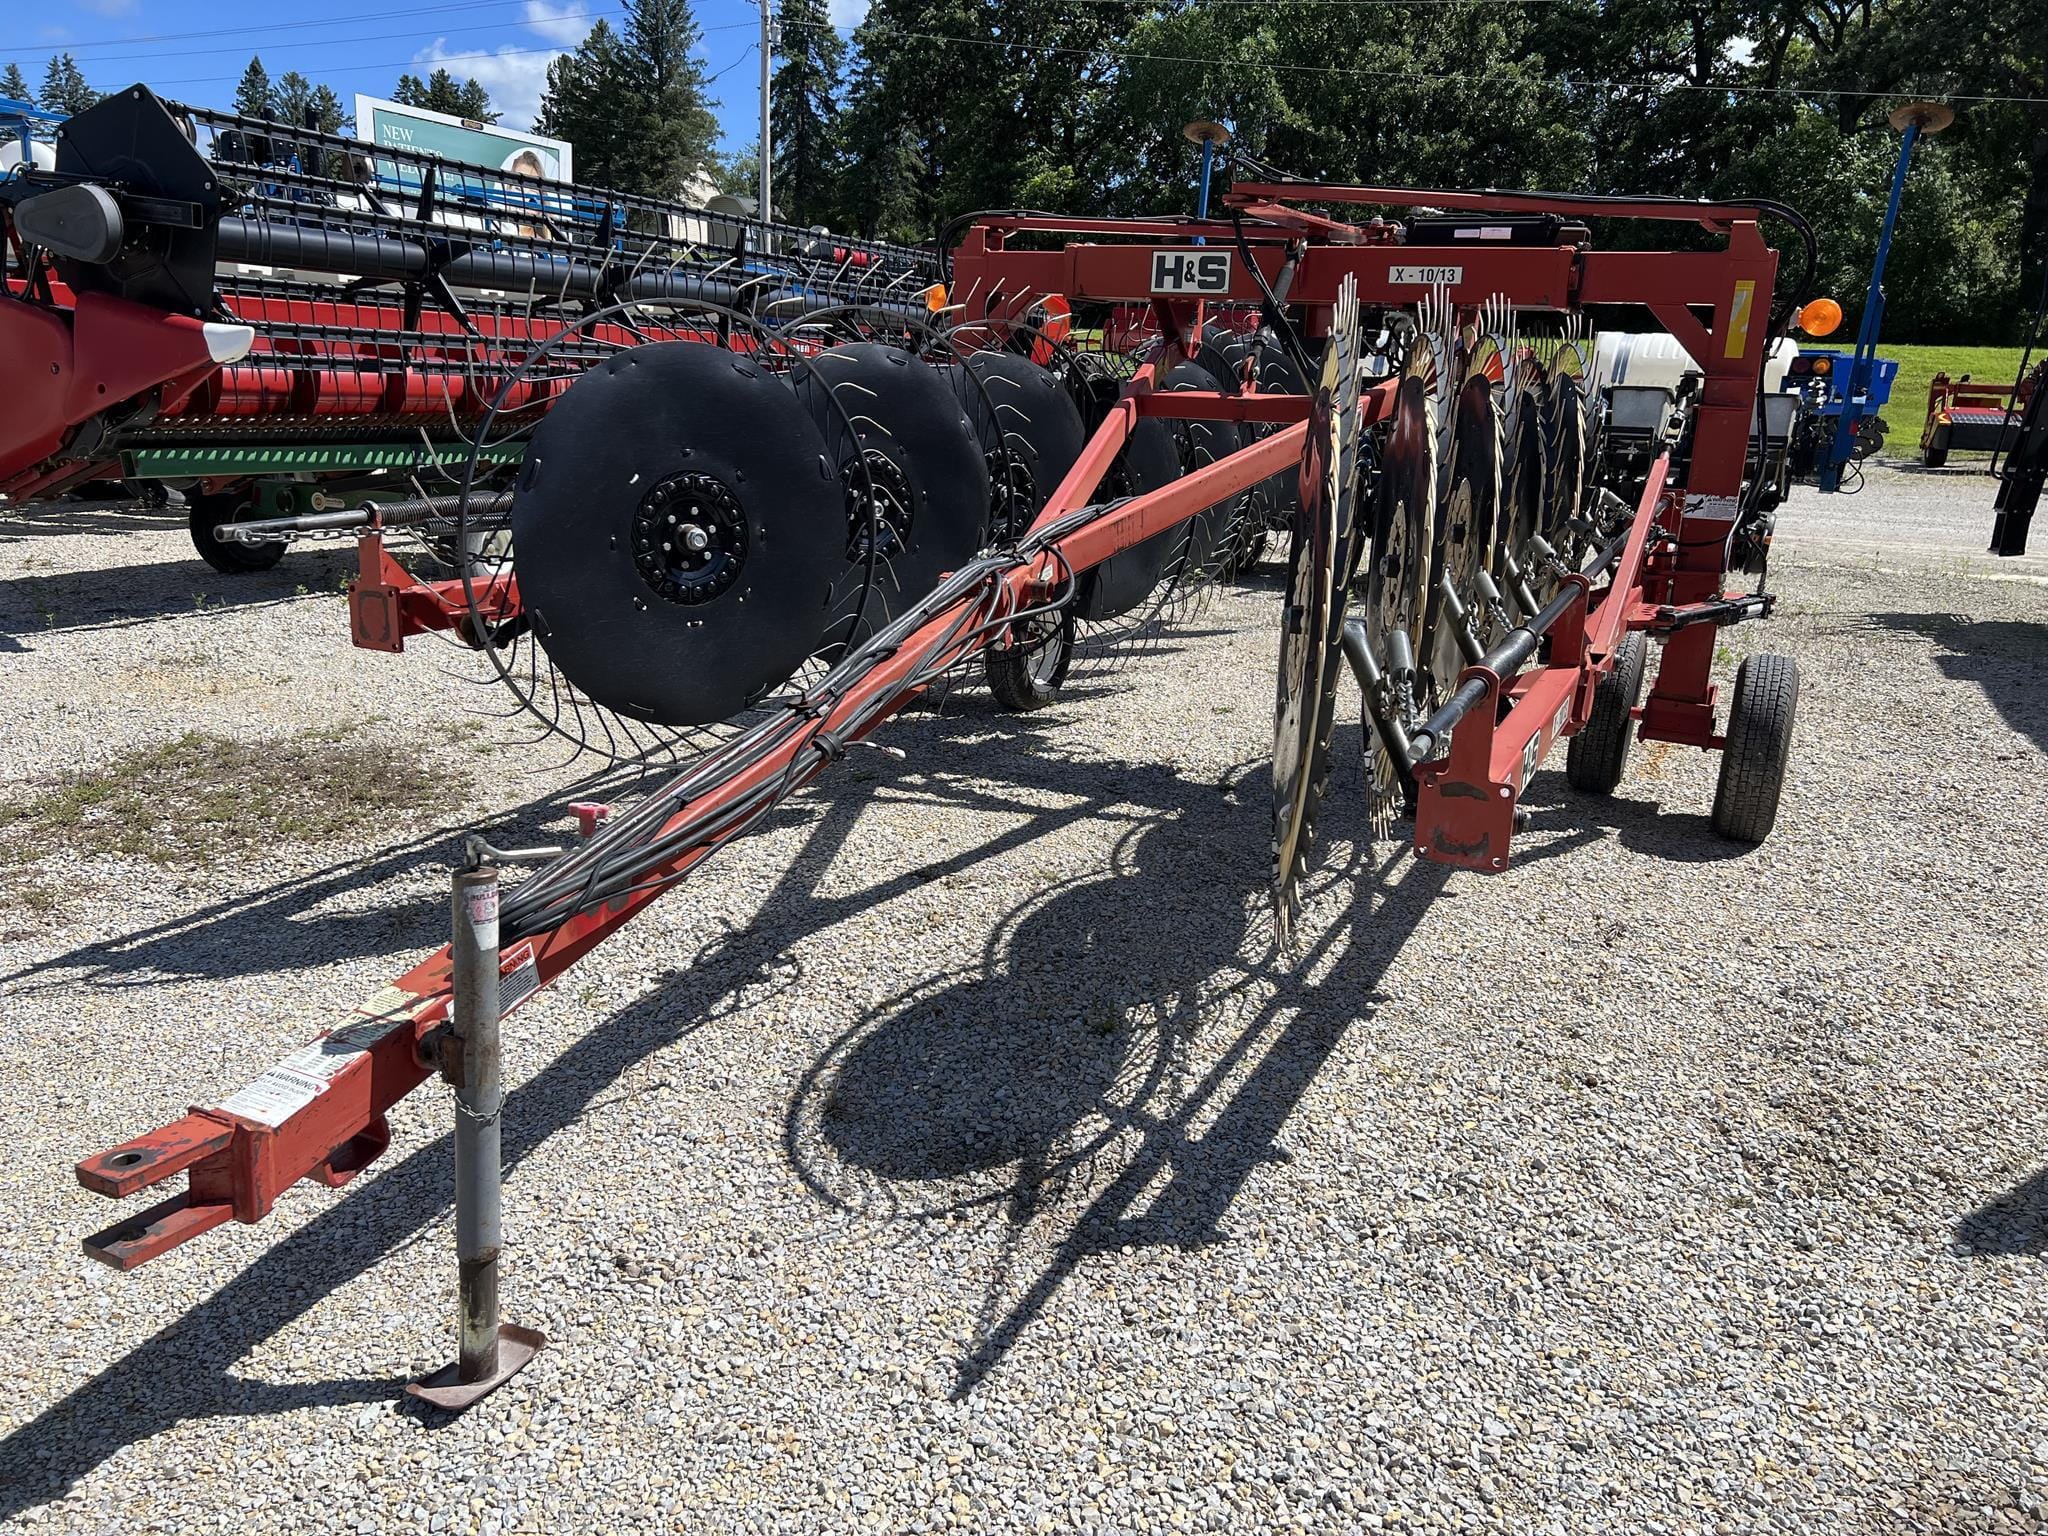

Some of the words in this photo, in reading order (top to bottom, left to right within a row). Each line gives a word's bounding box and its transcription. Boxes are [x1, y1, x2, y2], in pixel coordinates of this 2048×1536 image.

[382, 124, 413, 142] NEW
[1155, 255, 1227, 289] H&S
[1395, 268, 1405, 282] X
[1418, 268, 1456, 283] 10/13
